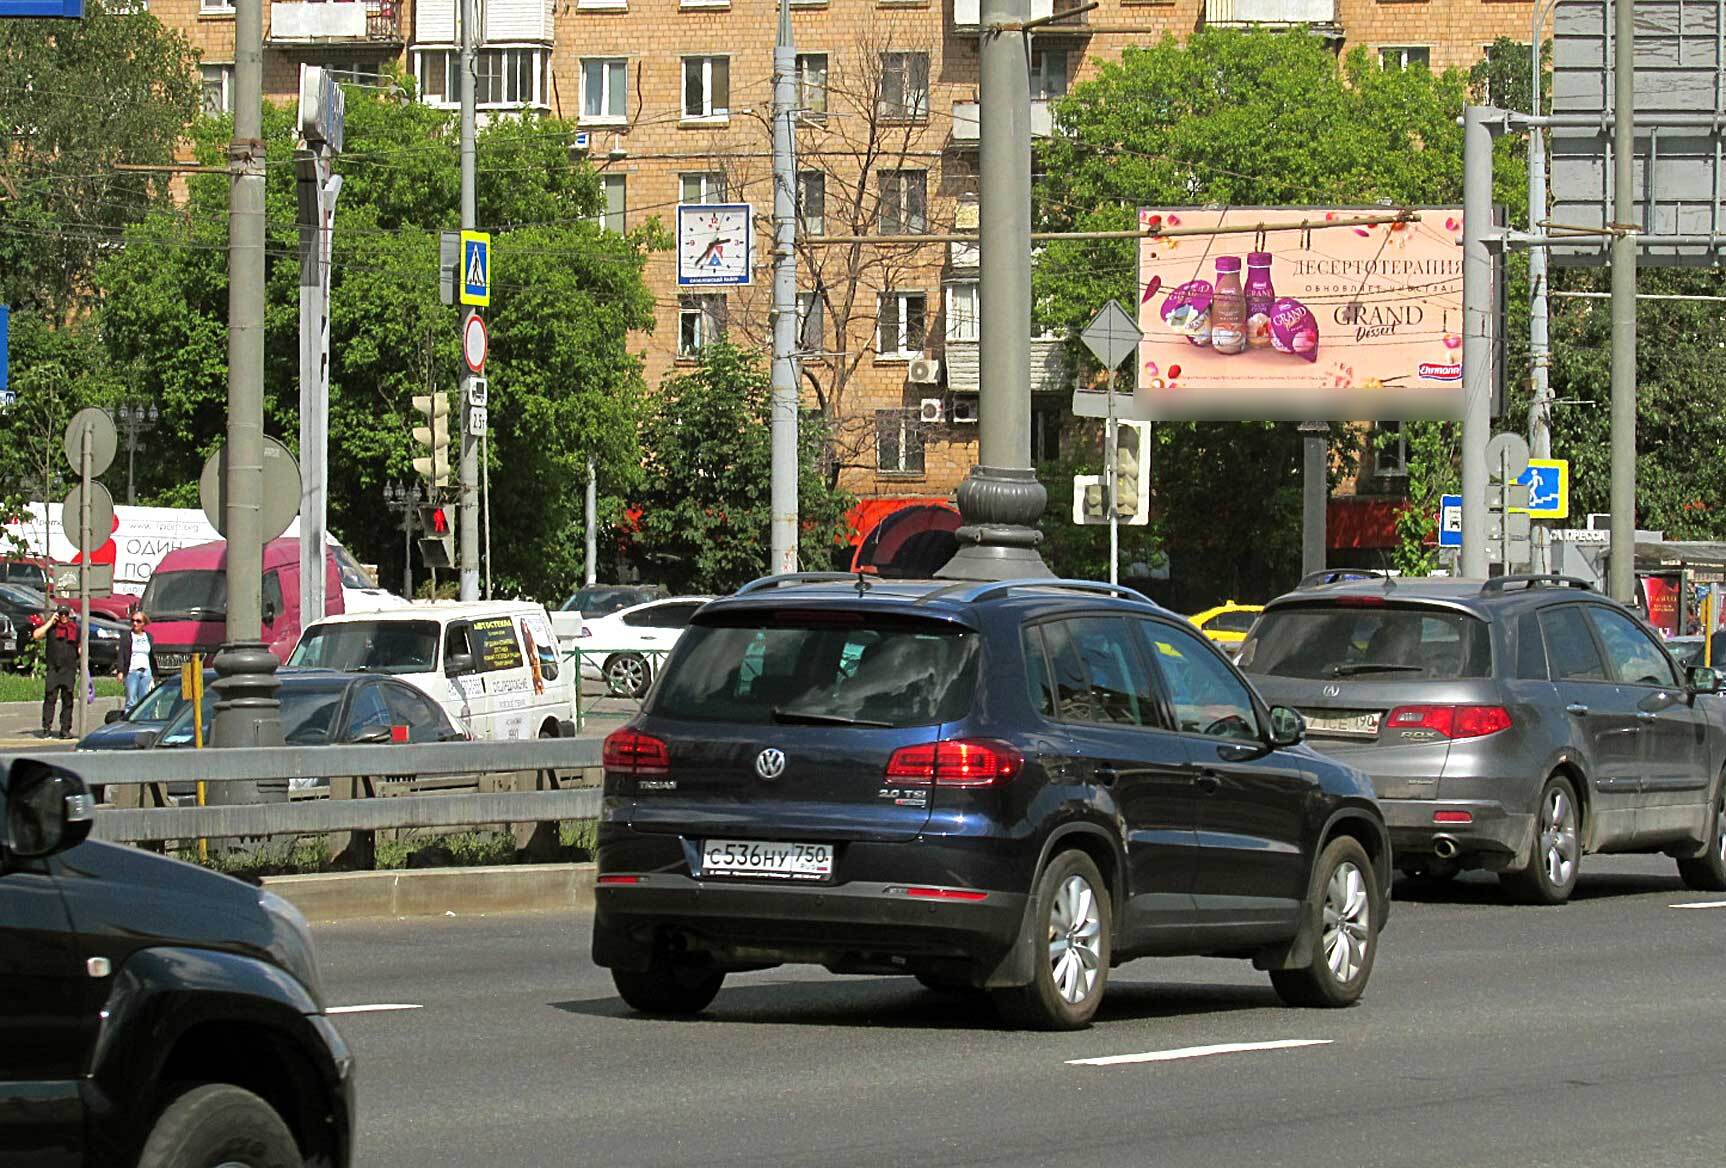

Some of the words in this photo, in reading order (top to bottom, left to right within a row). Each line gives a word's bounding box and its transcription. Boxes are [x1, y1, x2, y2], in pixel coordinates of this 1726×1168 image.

[1293, 259, 1463, 276] ДЕСЕРТОТЕРАПИЯ
[1305, 284, 1381, 293] ОБНОВЛЯЕТ
[1273, 306, 1307, 327] GRAND
[1333, 305, 1424, 326] GRAND
[1356, 321, 1398, 343] Dessert
[1419, 366, 1461, 376] Ehrmann
[1564, 529, 1606, 541] ПРЕССА
[795, 845, 826, 863] 750
